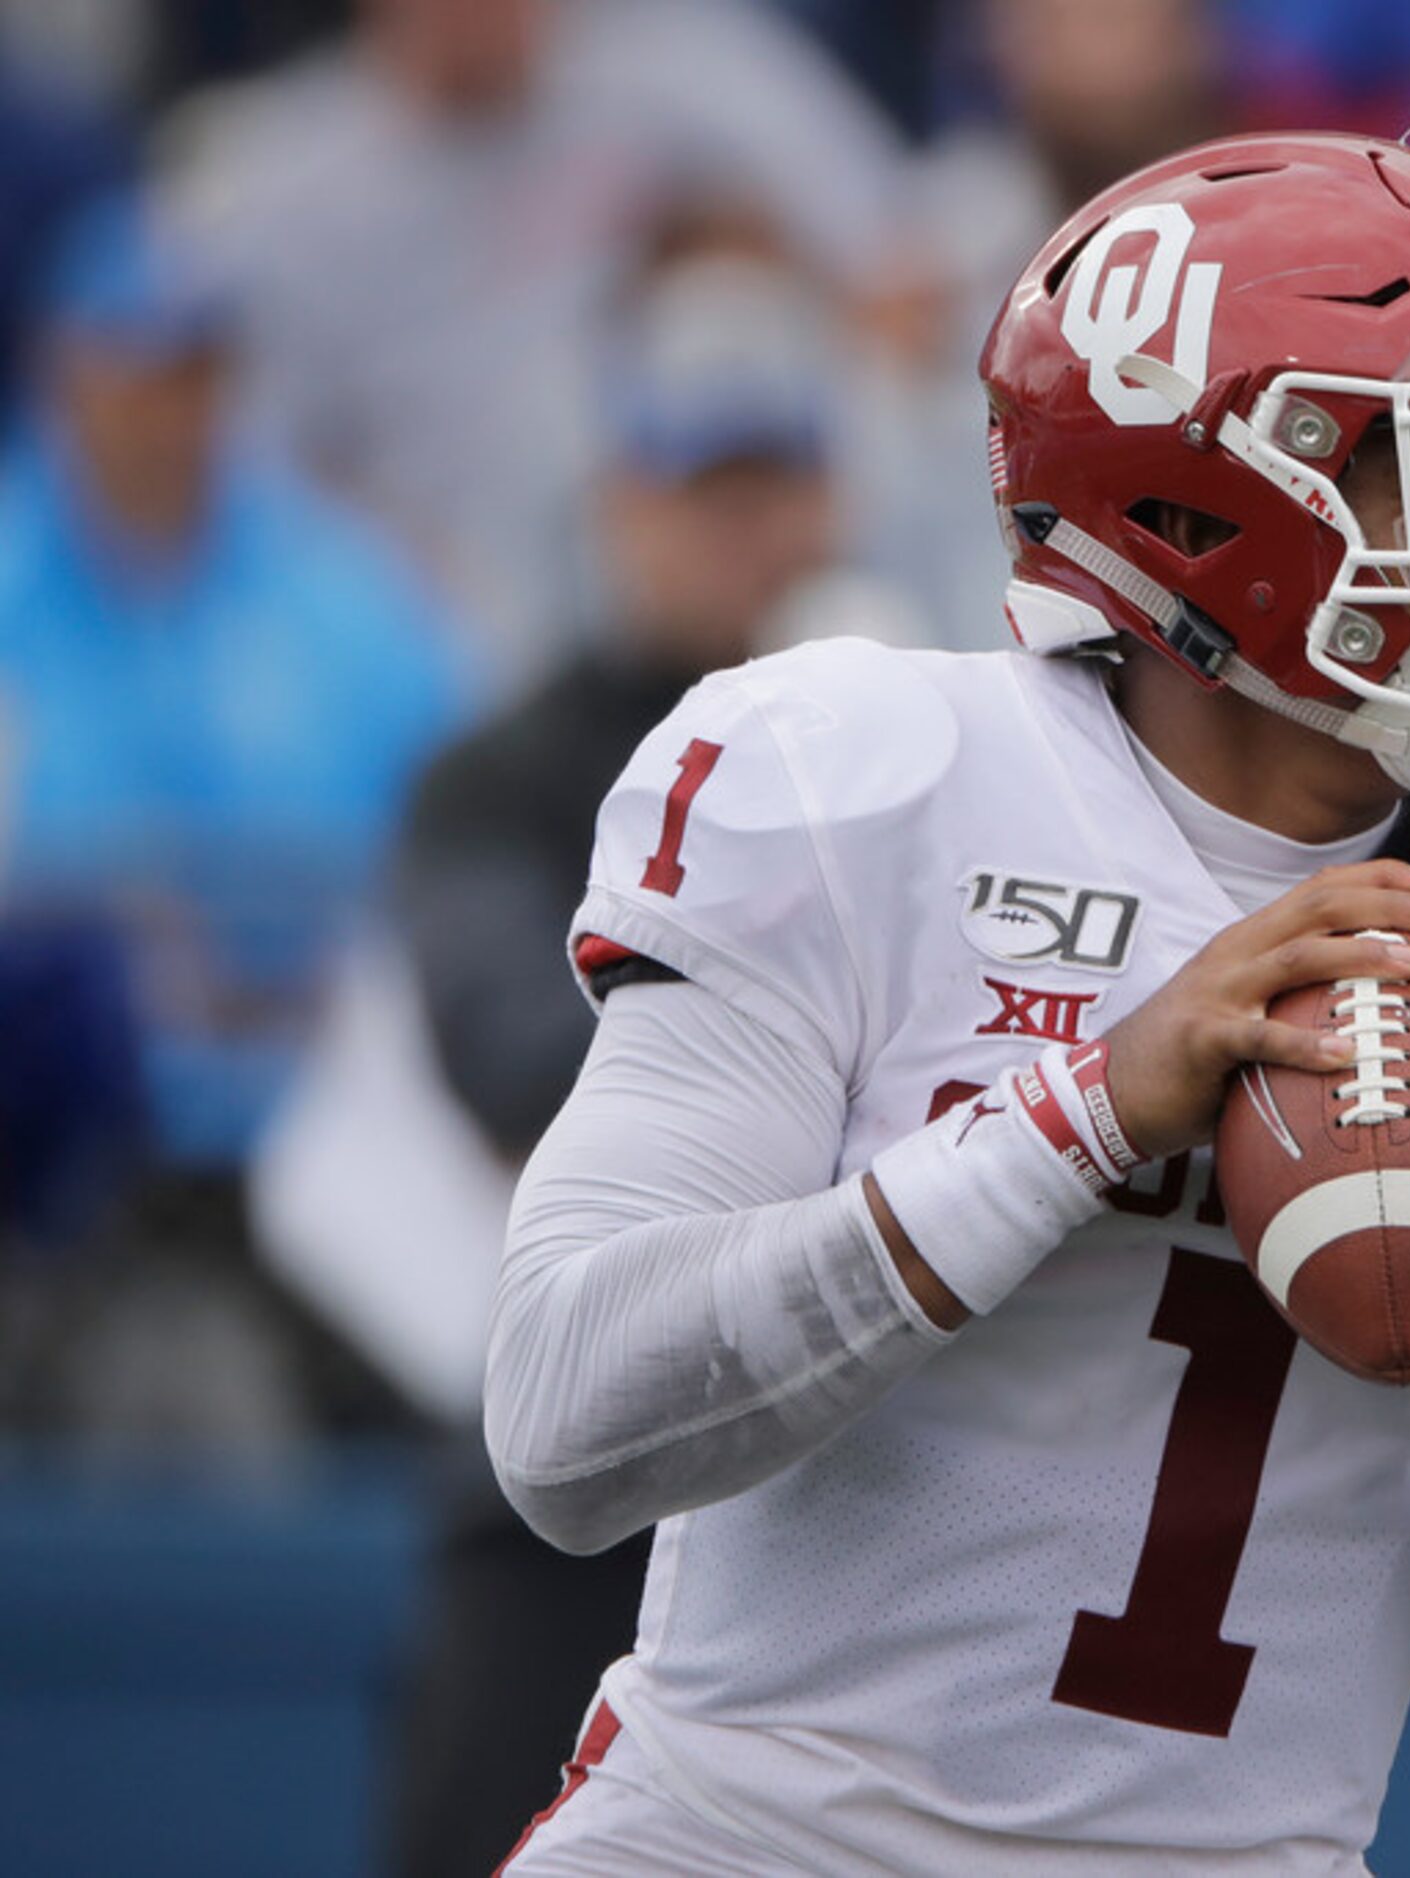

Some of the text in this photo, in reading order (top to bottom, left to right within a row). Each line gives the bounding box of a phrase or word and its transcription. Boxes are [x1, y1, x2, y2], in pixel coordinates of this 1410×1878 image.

[1061, 203, 1223, 427] OU
[639, 738, 725, 898] 1
[970, 873, 1139, 967] 150
[974, 976, 1098, 1046] XII
[1051, 1246, 1298, 1738] 1
